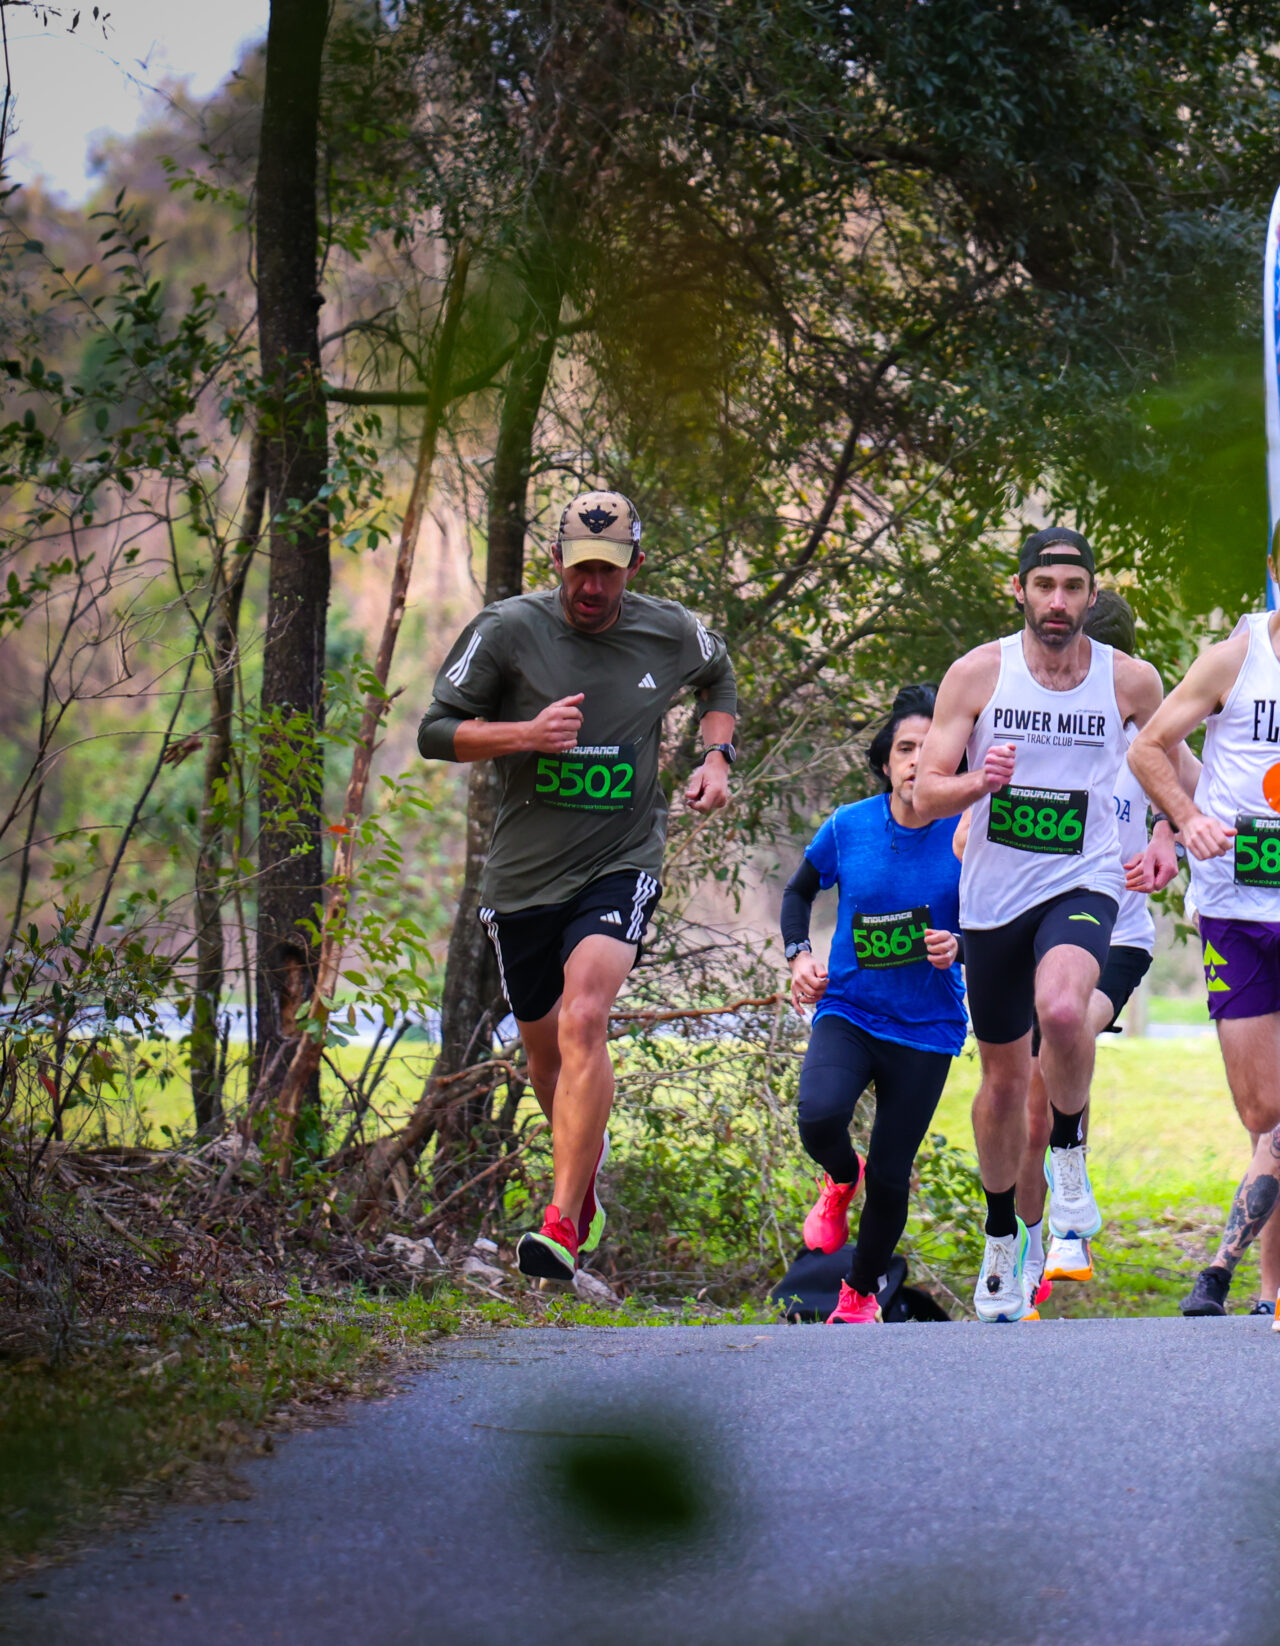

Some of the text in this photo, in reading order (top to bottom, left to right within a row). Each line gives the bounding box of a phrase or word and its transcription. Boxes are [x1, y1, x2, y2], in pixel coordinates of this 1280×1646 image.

[993, 708, 1106, 736] POWER MILER
[562, 746, 620, 755] NDURANCE
[1026, 733, 1073, 747] TRACK CLUB
[535, 758, 634, 799] 5502
[1009, 787, 1071, 801] ENDURANCE
[990, 797, 1083, 842] 5886
[862, 911, 913, 924] ENDURANCE
[853, 922, 929, 958] 5864
